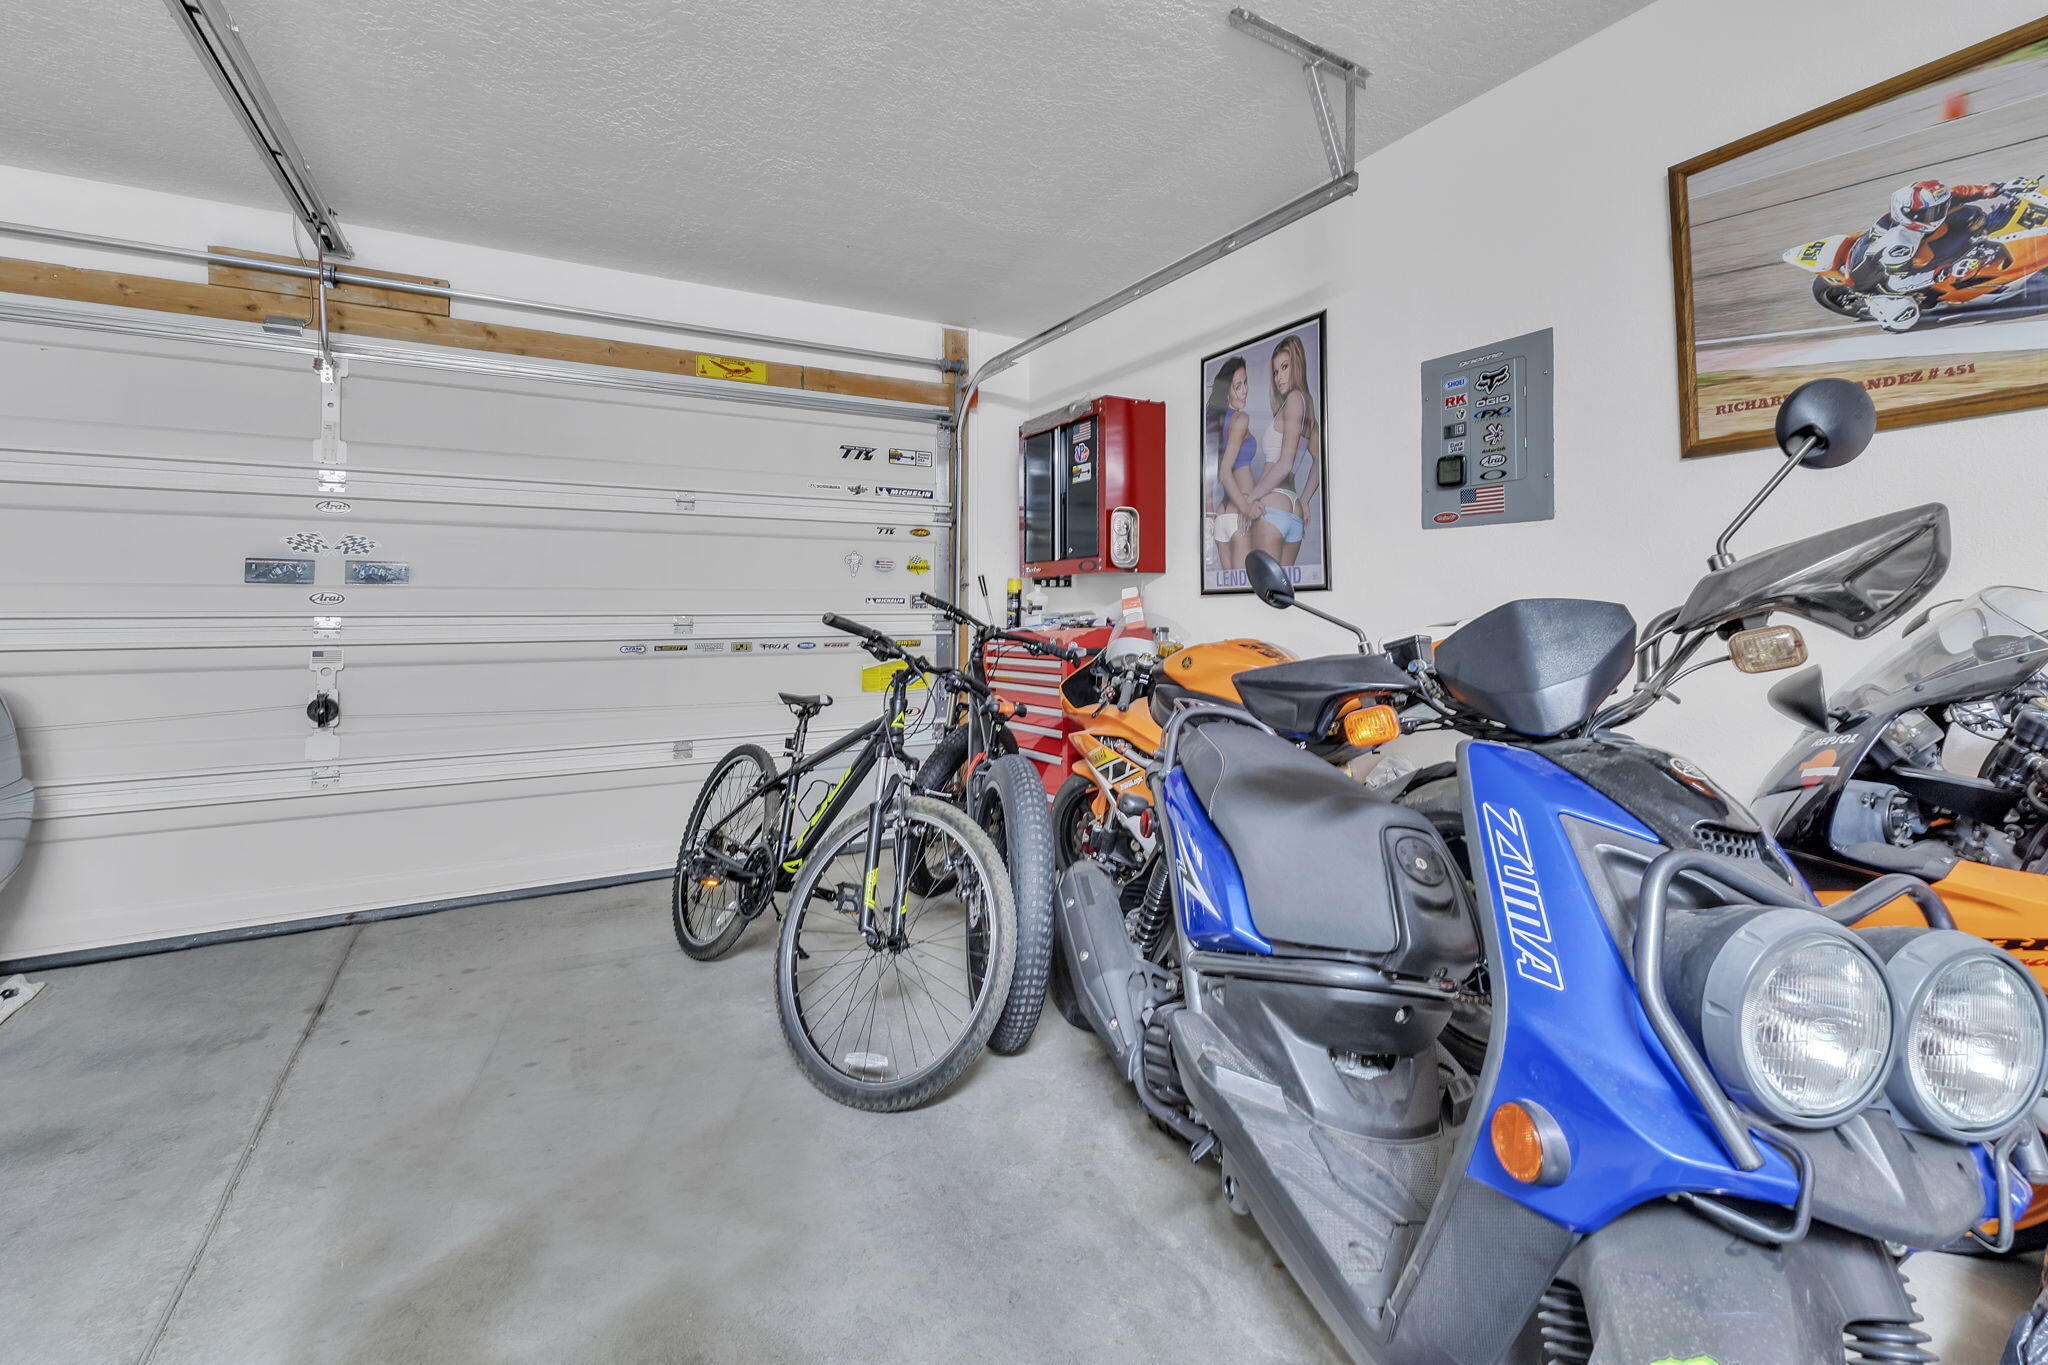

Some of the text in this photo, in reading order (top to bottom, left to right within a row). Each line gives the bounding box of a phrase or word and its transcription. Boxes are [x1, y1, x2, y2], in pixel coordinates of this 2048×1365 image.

[1447, 378, 1465, 389] SHOEI
[1715, 362, 1976, 416] RICHAR ANDEZ # 451
[1445, 394, 1467, 407] RK
[890, 490, 932, 498] MICHELIN
[1216, 569, 1247, 588] LEND
[1811, 733, 1860, 748] REPSOL
[1482, 801, 1565, 992] ZUMA
